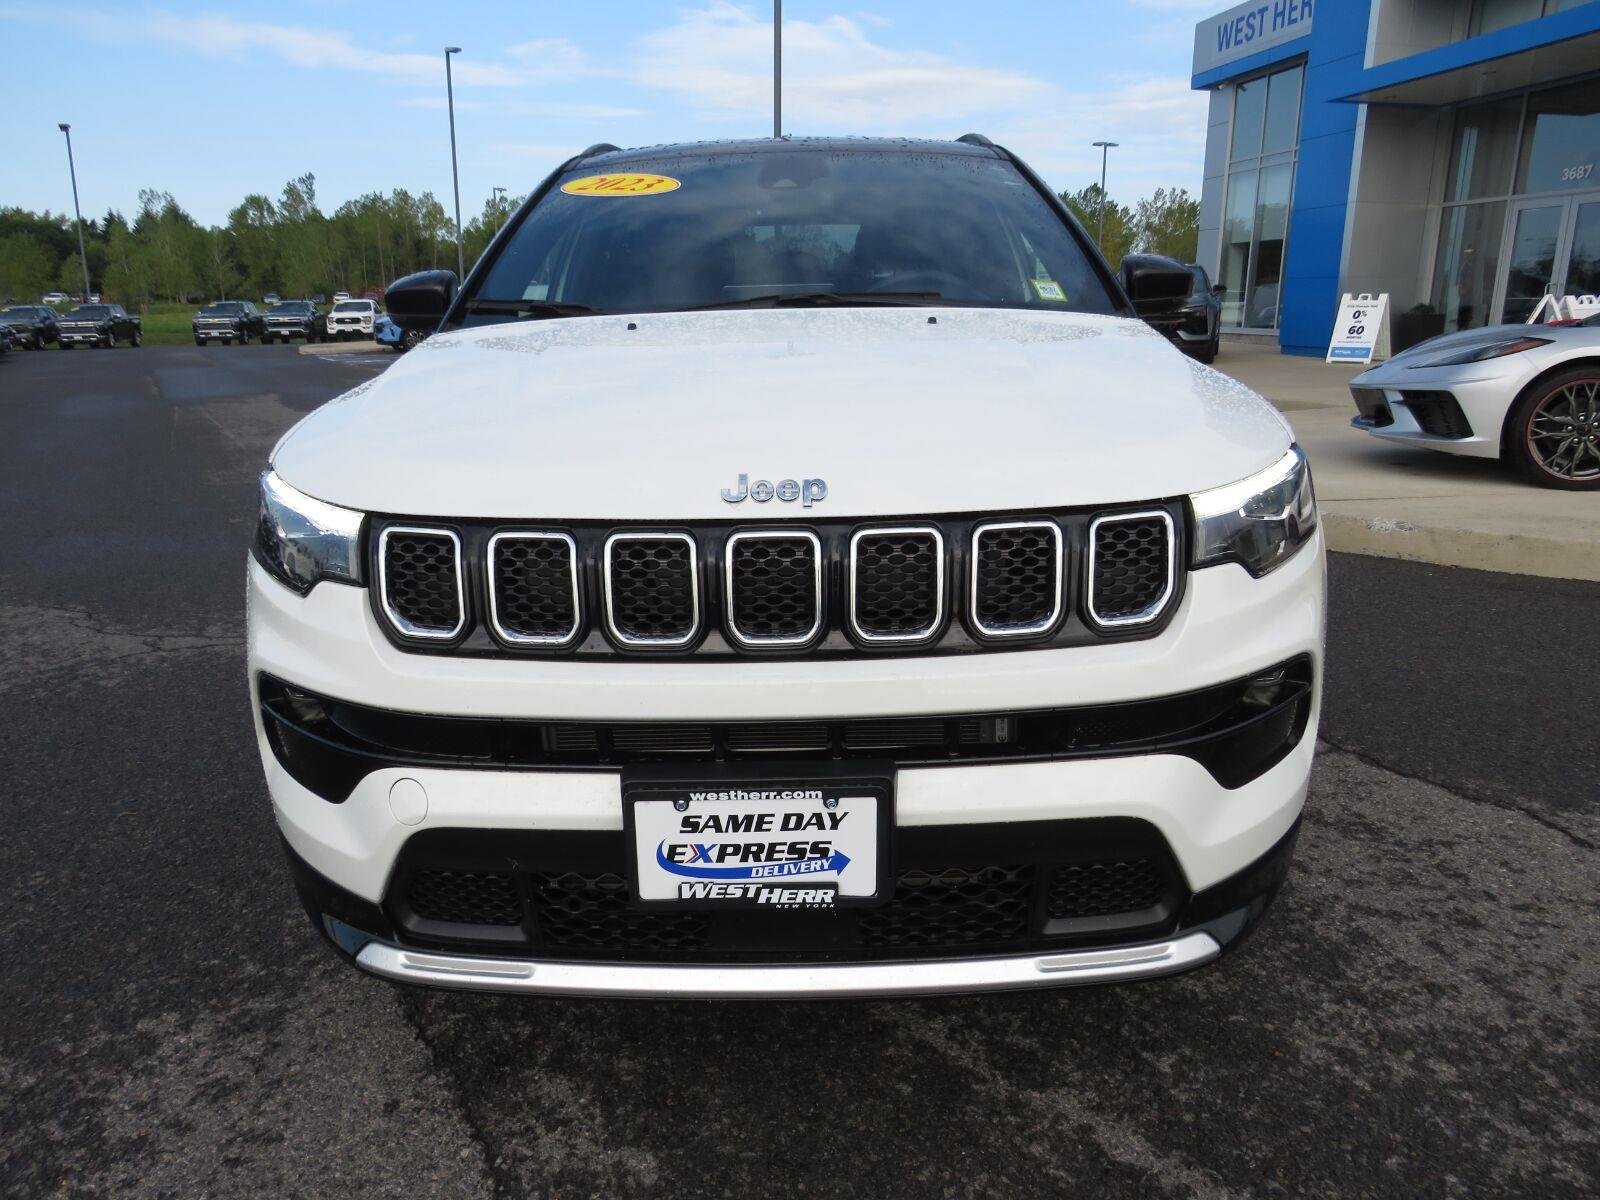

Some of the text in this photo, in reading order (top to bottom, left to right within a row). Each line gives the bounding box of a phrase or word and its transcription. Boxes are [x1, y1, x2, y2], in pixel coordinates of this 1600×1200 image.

[1217, 6, 1269, 52] WEST
[1561, 164, 1594, 181] 3687
[575, 177, 665, 192] 2023
[1352, 310, 1368, 319] 0%
[1348, 325, 1365, 335] 60
[720, 473, 829, 508] Jeep
[690, 790, 823, 801] westherr.com
[679, 812, 850, 834] SAME DAY
[666, 841, 832, 864] EXPRESS
[750, 857, 833, 879] DELIVERY
